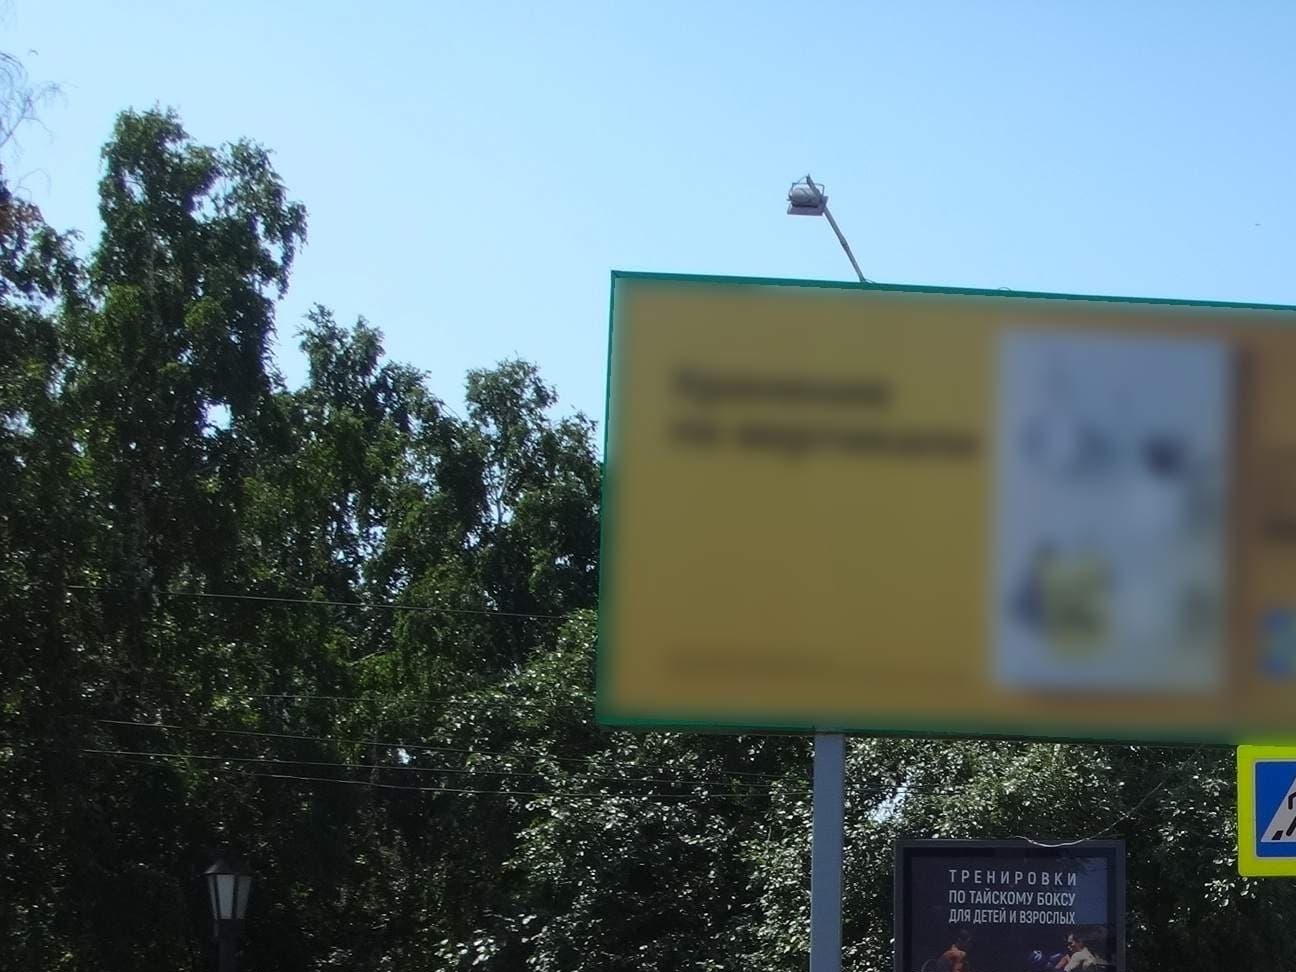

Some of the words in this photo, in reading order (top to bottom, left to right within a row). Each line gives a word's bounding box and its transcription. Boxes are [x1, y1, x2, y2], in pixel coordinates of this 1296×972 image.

[948, 869, 1077, 887] ТРЕНИРОВКИ
[948, 890, 966, 903] ПО
[969, 888, 1034, 905] ТАЙСКОМУ
[1037, 892, 1076, 906] БОКСУ
[948, 909, 971, 924] ДЛЯ
[973, 907, 1006, 924] ДЕТЕЙ
[1009, 909, 1017, 923] И
[1019, 910, 1076, 925] ВЗРОСЛЫХ
